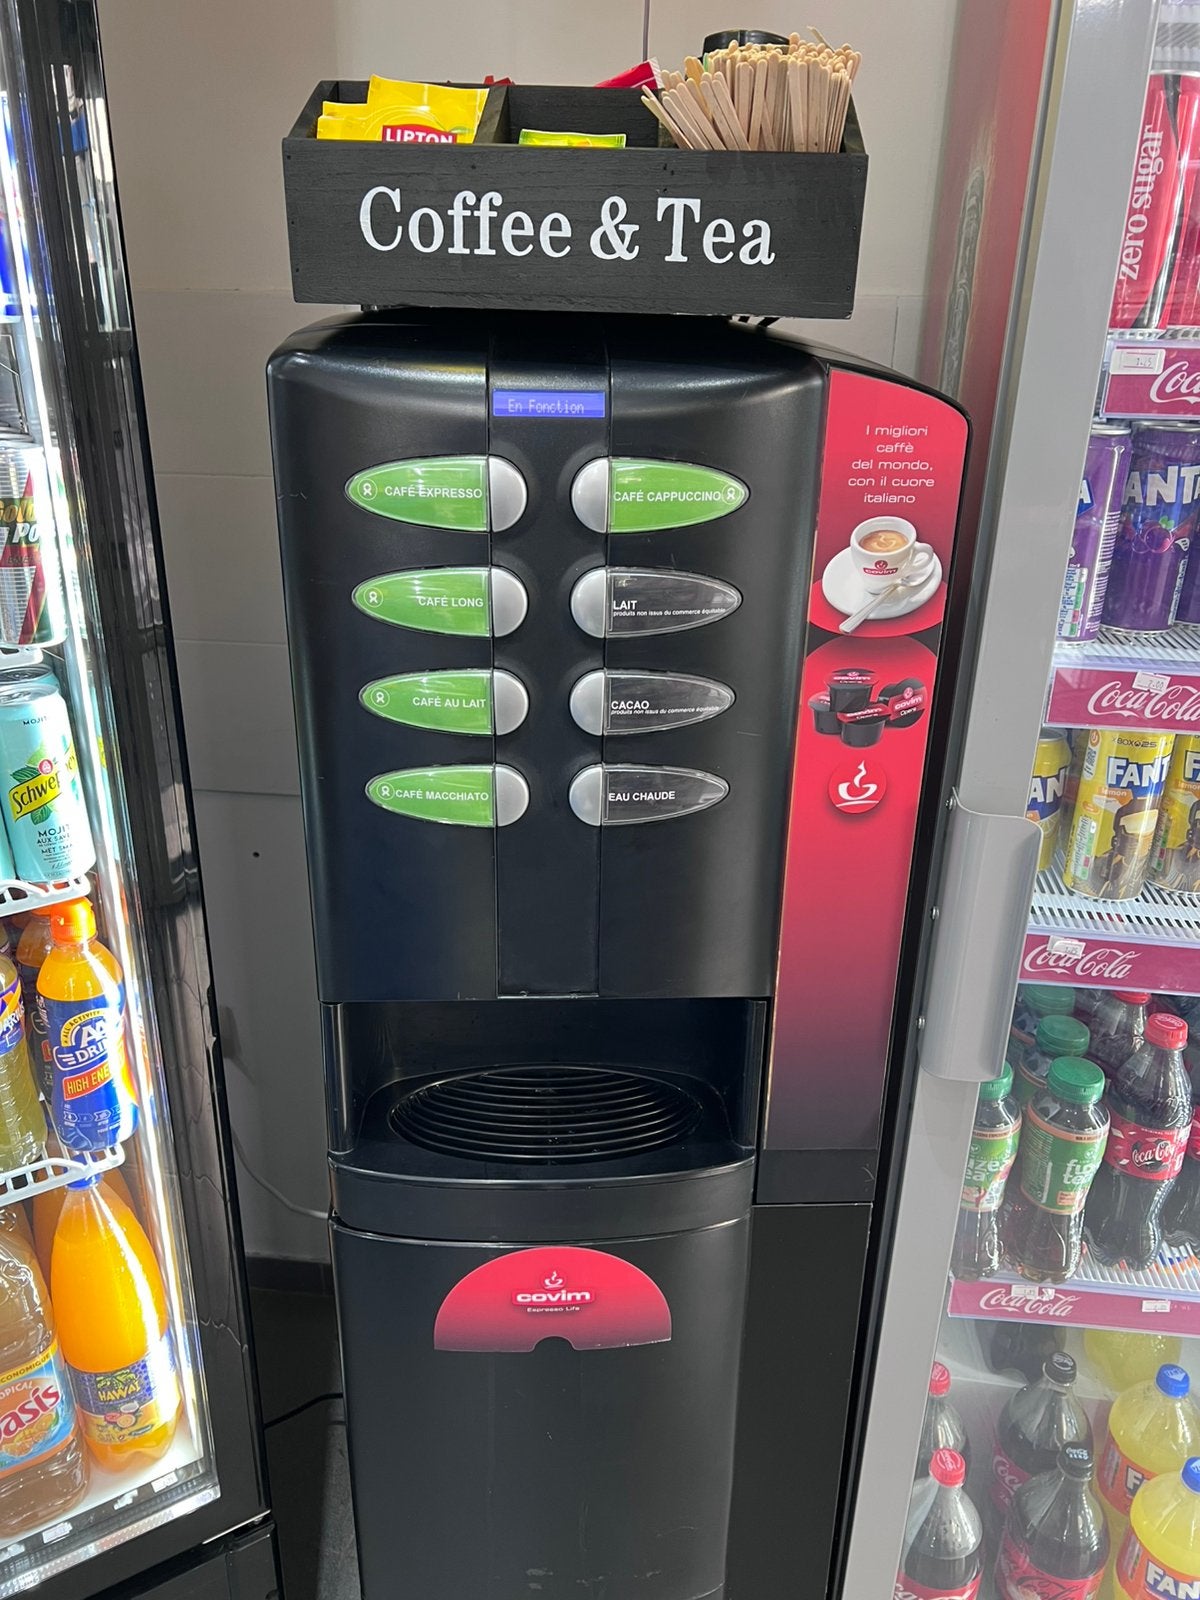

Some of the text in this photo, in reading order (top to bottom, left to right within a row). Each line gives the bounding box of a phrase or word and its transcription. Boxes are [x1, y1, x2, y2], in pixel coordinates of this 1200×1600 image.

[1119, 125, 1164, 281] zero sugar
[359, 186, 775, 265] Coffee & Tea
[508, 399, 584, 414] En Fonction
[866, 425, 928, 438] I migliori
[876, 442, 914, 453] caffè
[852, 459, 933, 471] del mondo,
[848, 476, 935, 487] con il cuore
[384, 484, 483, 498] CAFÉ EXPRESSO
[613, 490, 721, 502] CAFÉ CAPPUCCINO
[864, 493, 916, 503] italiano
[418, 595, 484, 607] CAFÉ LONG
[613, 600, 637, 610] LAIT
[412, 696, 486, 708] CAFÉ AU LAIT
[611, 700, 649, 709] CACAO
[395, 789, 489, 801] CAFÉ MACCHIATO
[609, 791, 676, 802] EAU CHAUDE
[67, 1077, 89, 1094] HIGH
[516, 1289, 591, 1302] covim
[0, 1385, 60, 1438] asis
